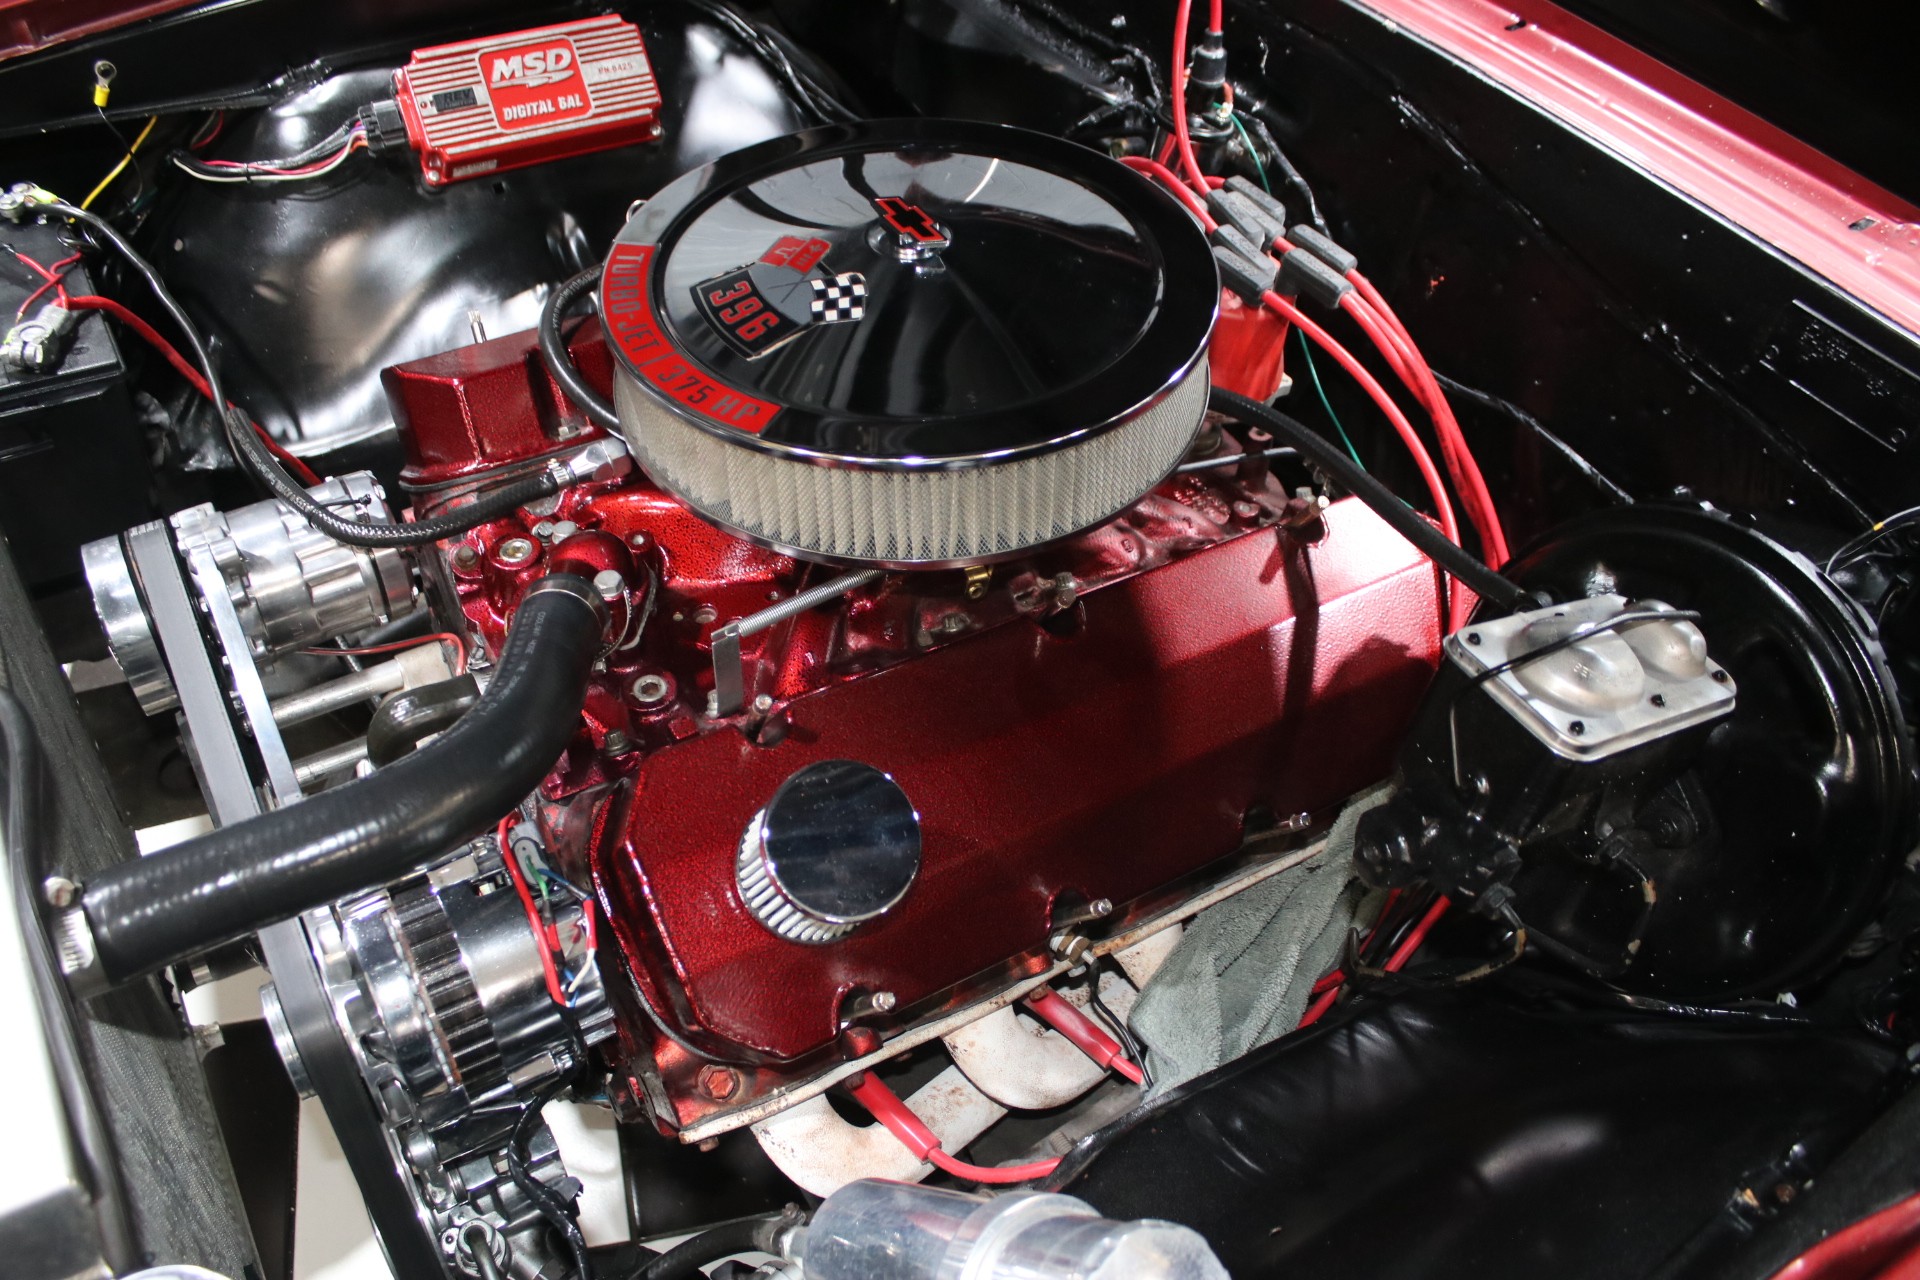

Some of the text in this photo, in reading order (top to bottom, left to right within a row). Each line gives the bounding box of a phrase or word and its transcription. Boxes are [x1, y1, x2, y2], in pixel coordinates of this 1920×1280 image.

[491, 47, 573, 82] MSD
[502, 98, 556, 122] DIGITAL
[709, 280, 780, 341] 396
[609, 252, 761, 421] TURBO-JET 375 HP
